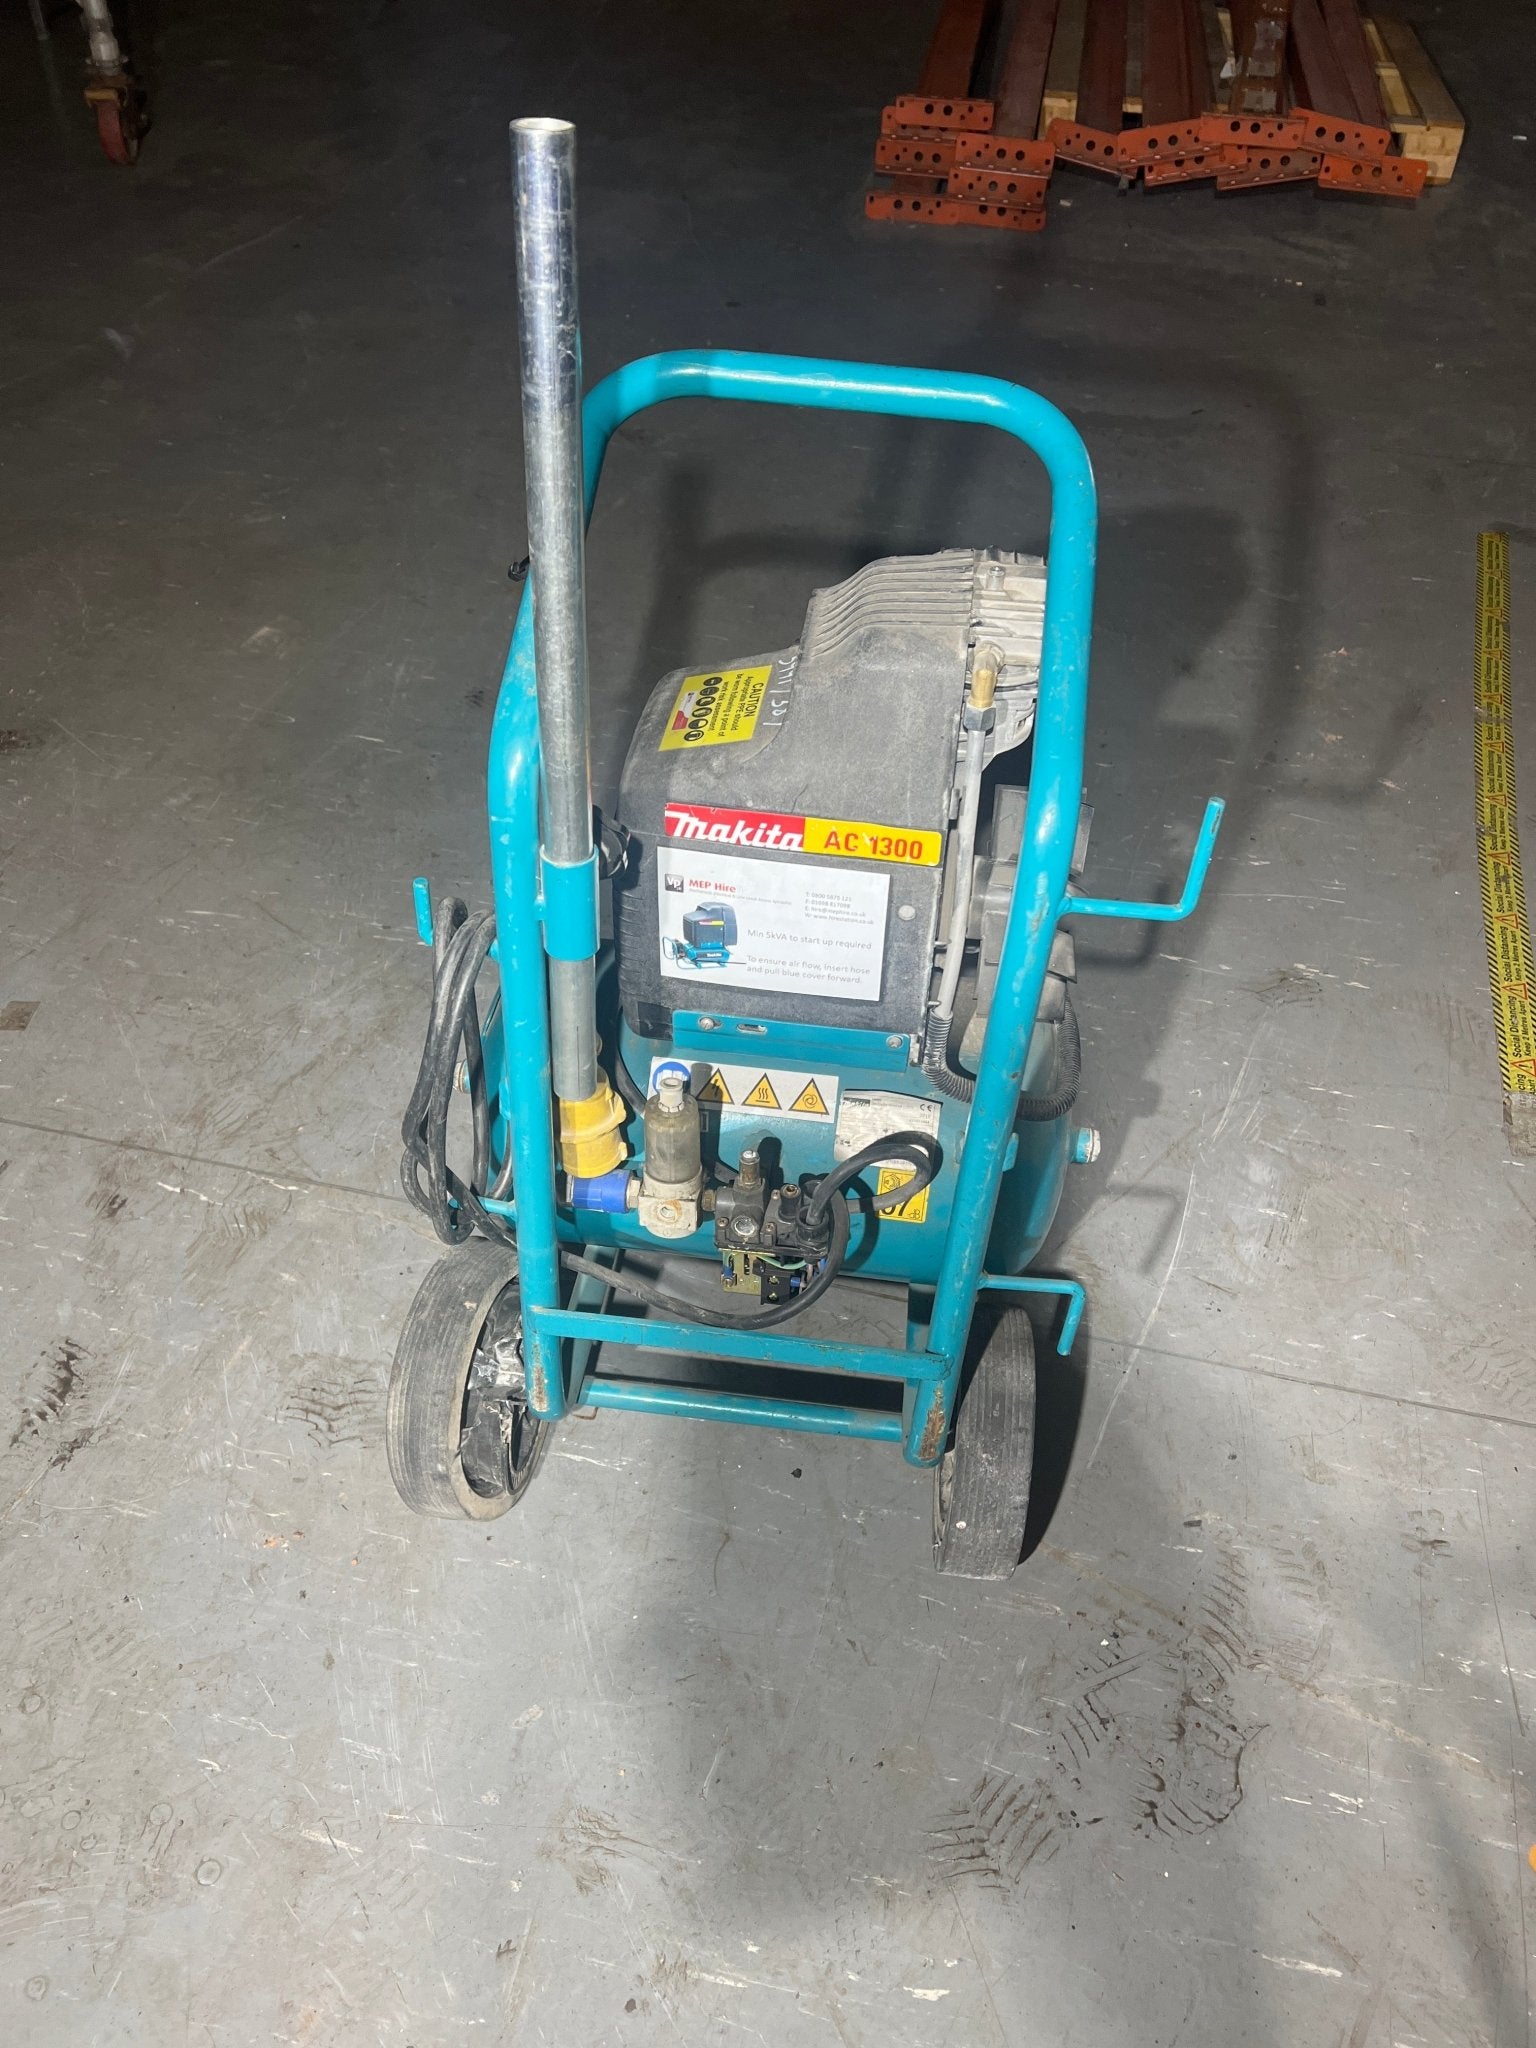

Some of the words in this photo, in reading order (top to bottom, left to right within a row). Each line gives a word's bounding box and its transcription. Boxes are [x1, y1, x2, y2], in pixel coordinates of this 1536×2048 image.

[744, 682, 764, 718] CAUTION
[824, 831, 858, 852] AC
[869, 836, 923, 859] 1300
[1490, 833, 1498, 851] Social
[688, 879, 711, 889] MEP
[714, 882, 736, 893] Hire
[1492, 861, 1502, 892] Distancing
[1496, 894, 1505, 913] Social
[747, 929, 764, 938] Min
[766, 931, 787, 941] 5kVA
[789, 934, 798, 942] to
[800, 936, 820, 945] start
[822, 938, 834, 947] up
[835, 939, 872, 950] required
[1499, 926, 1509, 959] Distancing
[746, 965, 762, 974] and
[764, 967, 780, 976] pull
[782, 968, 800, 978] blue
[802, 972, 825, 981] cover
[747, 954, 757, 962] To
[758, 957, 787, 967] ensure
[789, 959, 800, 967] air
[824, 963, 848, 973] insert
[850, 965, 870, 975] hose
[1503, 959, 1512, 982] Social
[1521, 1016, 1529, 1035] Metres
[1512, 1034, 1522, 1058] Social
[1523, 1041, 1532, 1056] Keep
